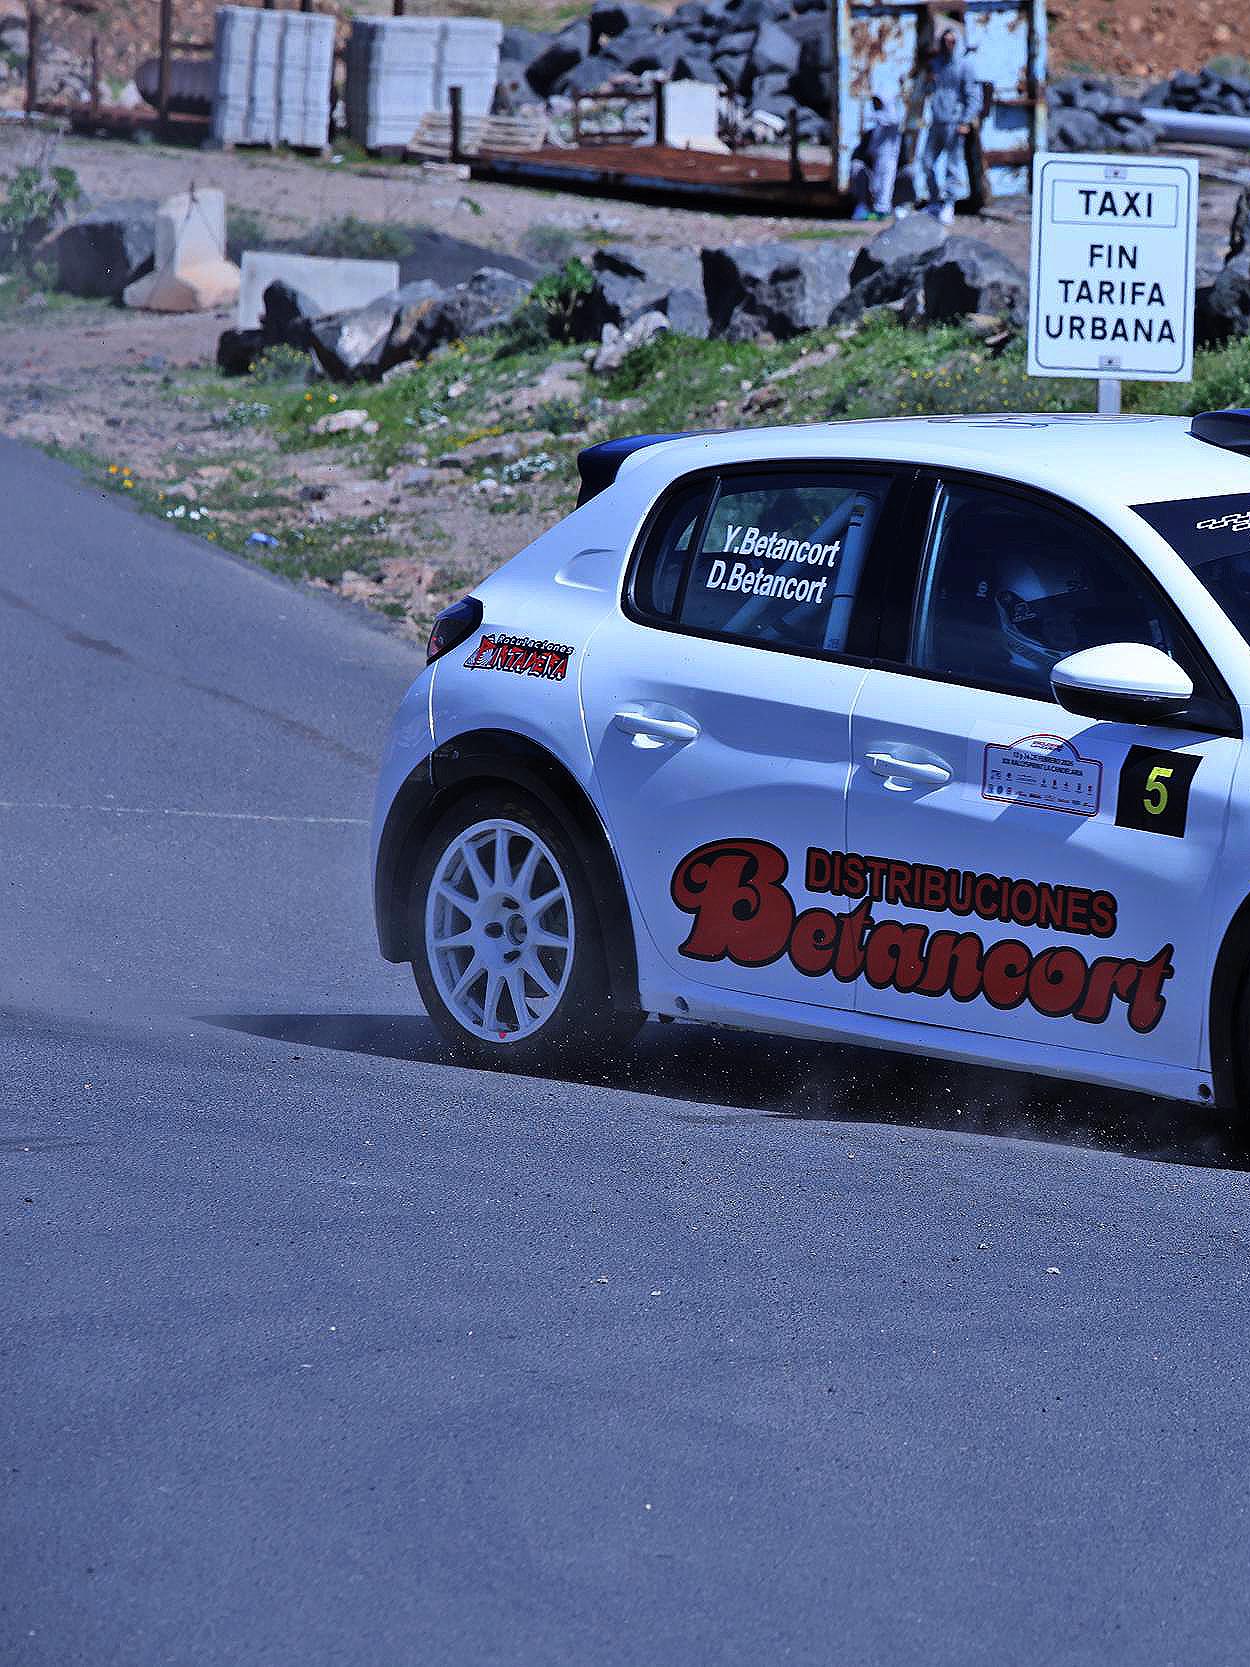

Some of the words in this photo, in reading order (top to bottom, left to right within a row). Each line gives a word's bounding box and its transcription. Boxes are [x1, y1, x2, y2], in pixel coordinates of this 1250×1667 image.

[1079, 190, 1152, 217] TAXI
[1090, 244, 1137, 269] FIN
[1059, 280, 1165, 306] TARIFA
[1046, 315, 1175, 343] URBANA
[723, 525, 841, 567] Y.Betancort
[706, 560, 827, 604] D.Betancort
[1143, 766, 1174, 815] 5
[805, 847, 1118, 938] DISTRIBUCIONES
[670, 838, 1175, 1034] Betancort
